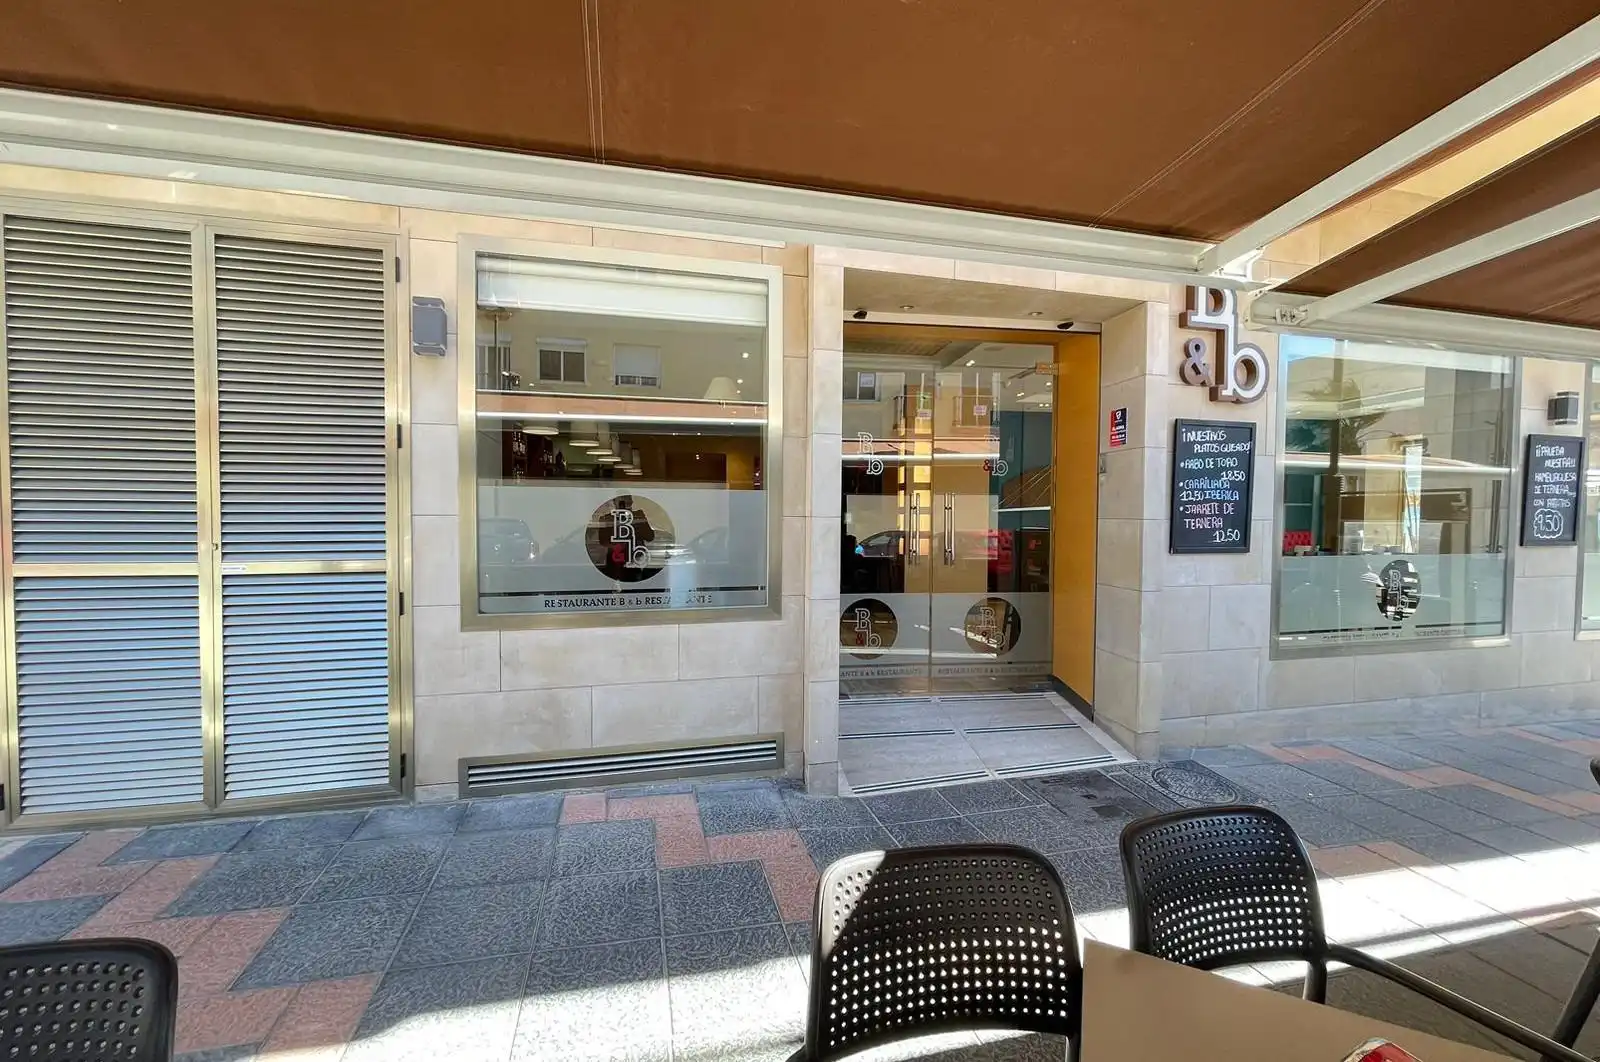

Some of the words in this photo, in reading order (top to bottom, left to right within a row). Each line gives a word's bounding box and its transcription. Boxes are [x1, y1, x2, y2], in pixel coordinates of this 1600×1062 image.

[1194, 443, 1220, 454] PLATOS
[1205, 458, 1215, 468] DE
[1215, 457, 1238, 468] TORO
[1223, 503, 1235, 514] DE
[544, 597, 617, 608] RESTAURANTE
[618, 598, 626, 606] B
